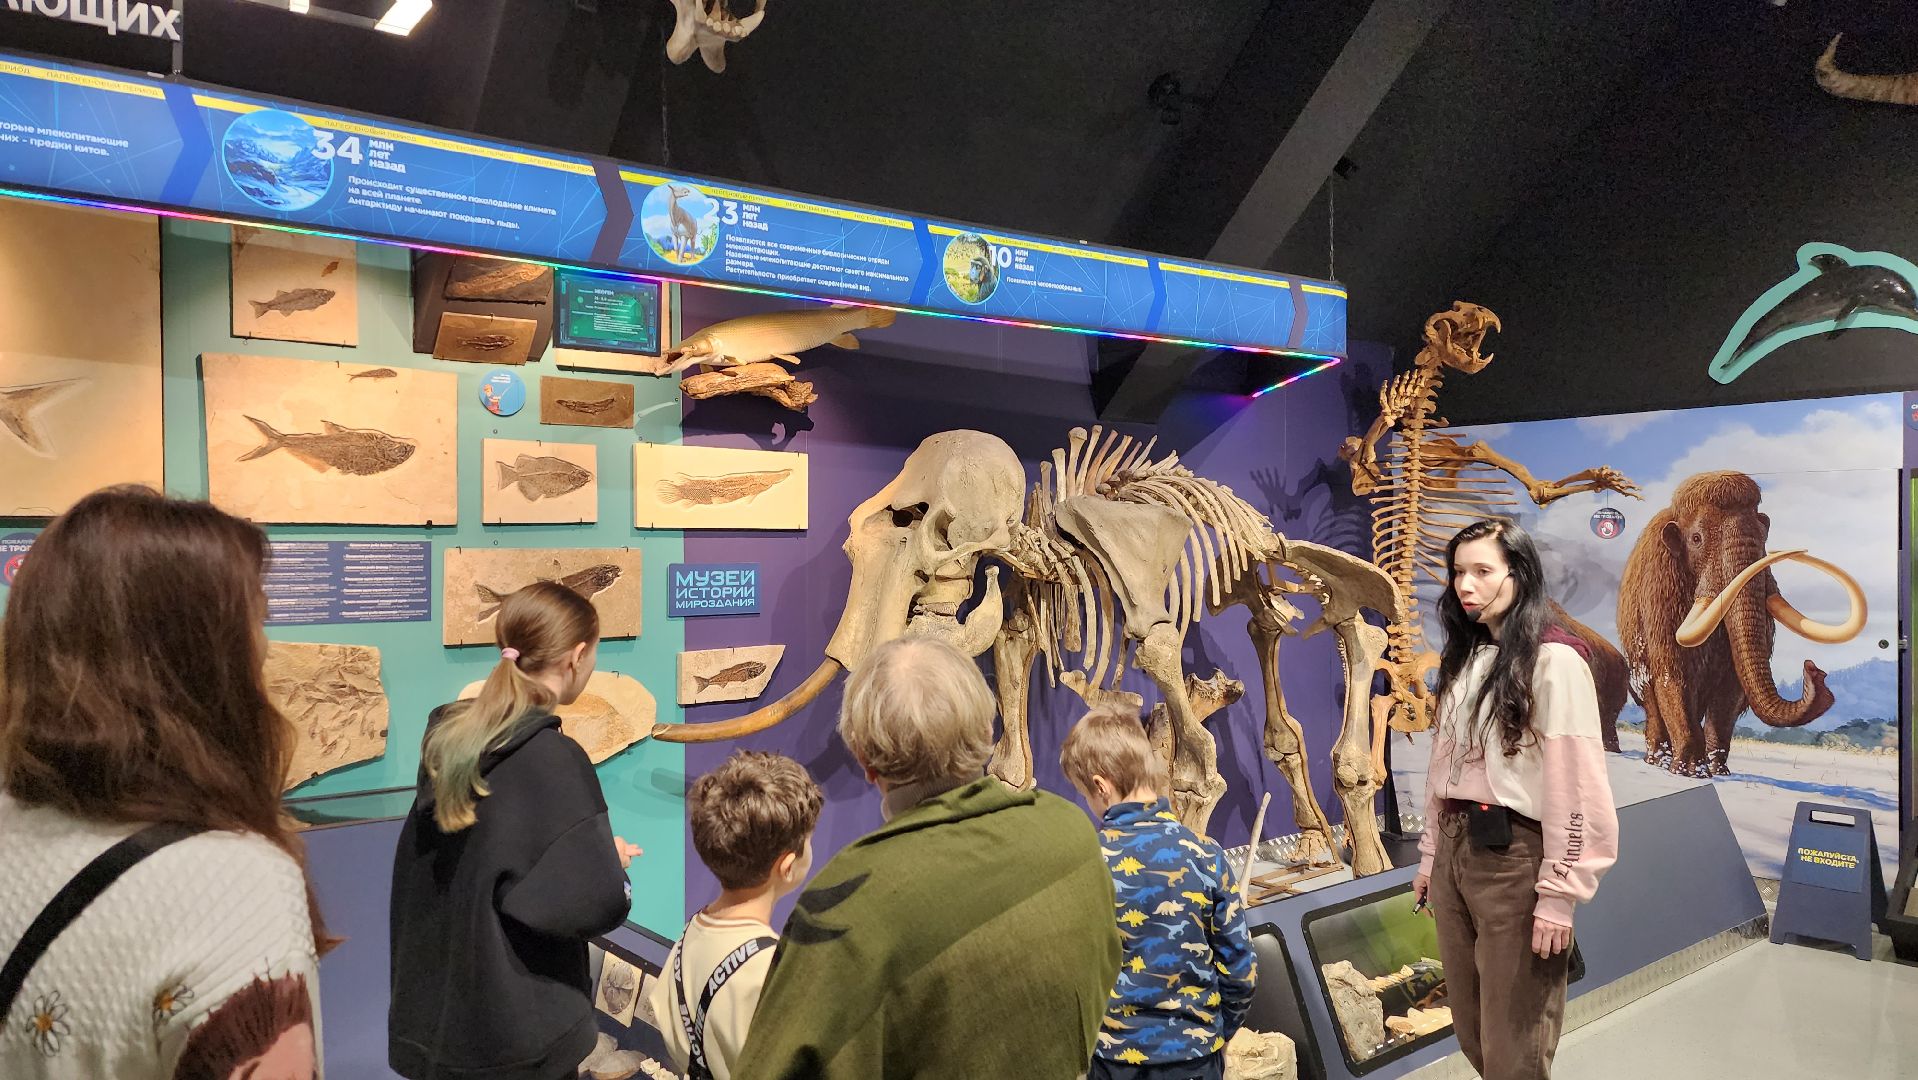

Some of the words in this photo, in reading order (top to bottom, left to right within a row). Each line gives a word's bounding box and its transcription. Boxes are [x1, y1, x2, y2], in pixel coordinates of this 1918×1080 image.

[36, 127, 129, 148] млекопитающие
[30, 138, 72, 151] предки
[74, 144, 110, 156] китов.
[311, 129, 363, 165] 34
[368, 139, 394, 152] млн
[368, 149, 391, 160] лет
[368, 159, 406, 173] назад
[348, 186, 360, 195] на
[361, 188, 384, 199] всей
[348, 175, 404, 191] Происходит
[405, 185, 468, 202] существенное
[523, 205, 557, 216] климата
[348, 196, 402, 212] Антарктиду
[404, 206, 448, 219] начинают
[449, 212, 495, 226] покрывать
[703, 197, 739, 225] 23
[742, 203, 761, 213] млн
[742, 211, 758, 221] лет
[742, 219, 769, 232] назад
[725, 234, 766, 247] Появляются
[988, 246, 1012, 268] 10
[1015, 248, 1029, 257] млн
[725, 266, 776, 279] Растительность
[1014, 263, 1035, 272] назад
[675, 569, 755, 587] МУЗЕЙ
[675, 586, 755, 599] ИСТОРИИ
[675, 599, 755, 609] МИРОЗДАНИЯ
[1797, 847, 1860, 864] ПОЖАЛУЙСТА,
[1800, 855, 1813, 863] НЕ
[1813, 857, 1856, 869] ВХОДИТЕ
[708, 939, 759, 997] ACTIVE
